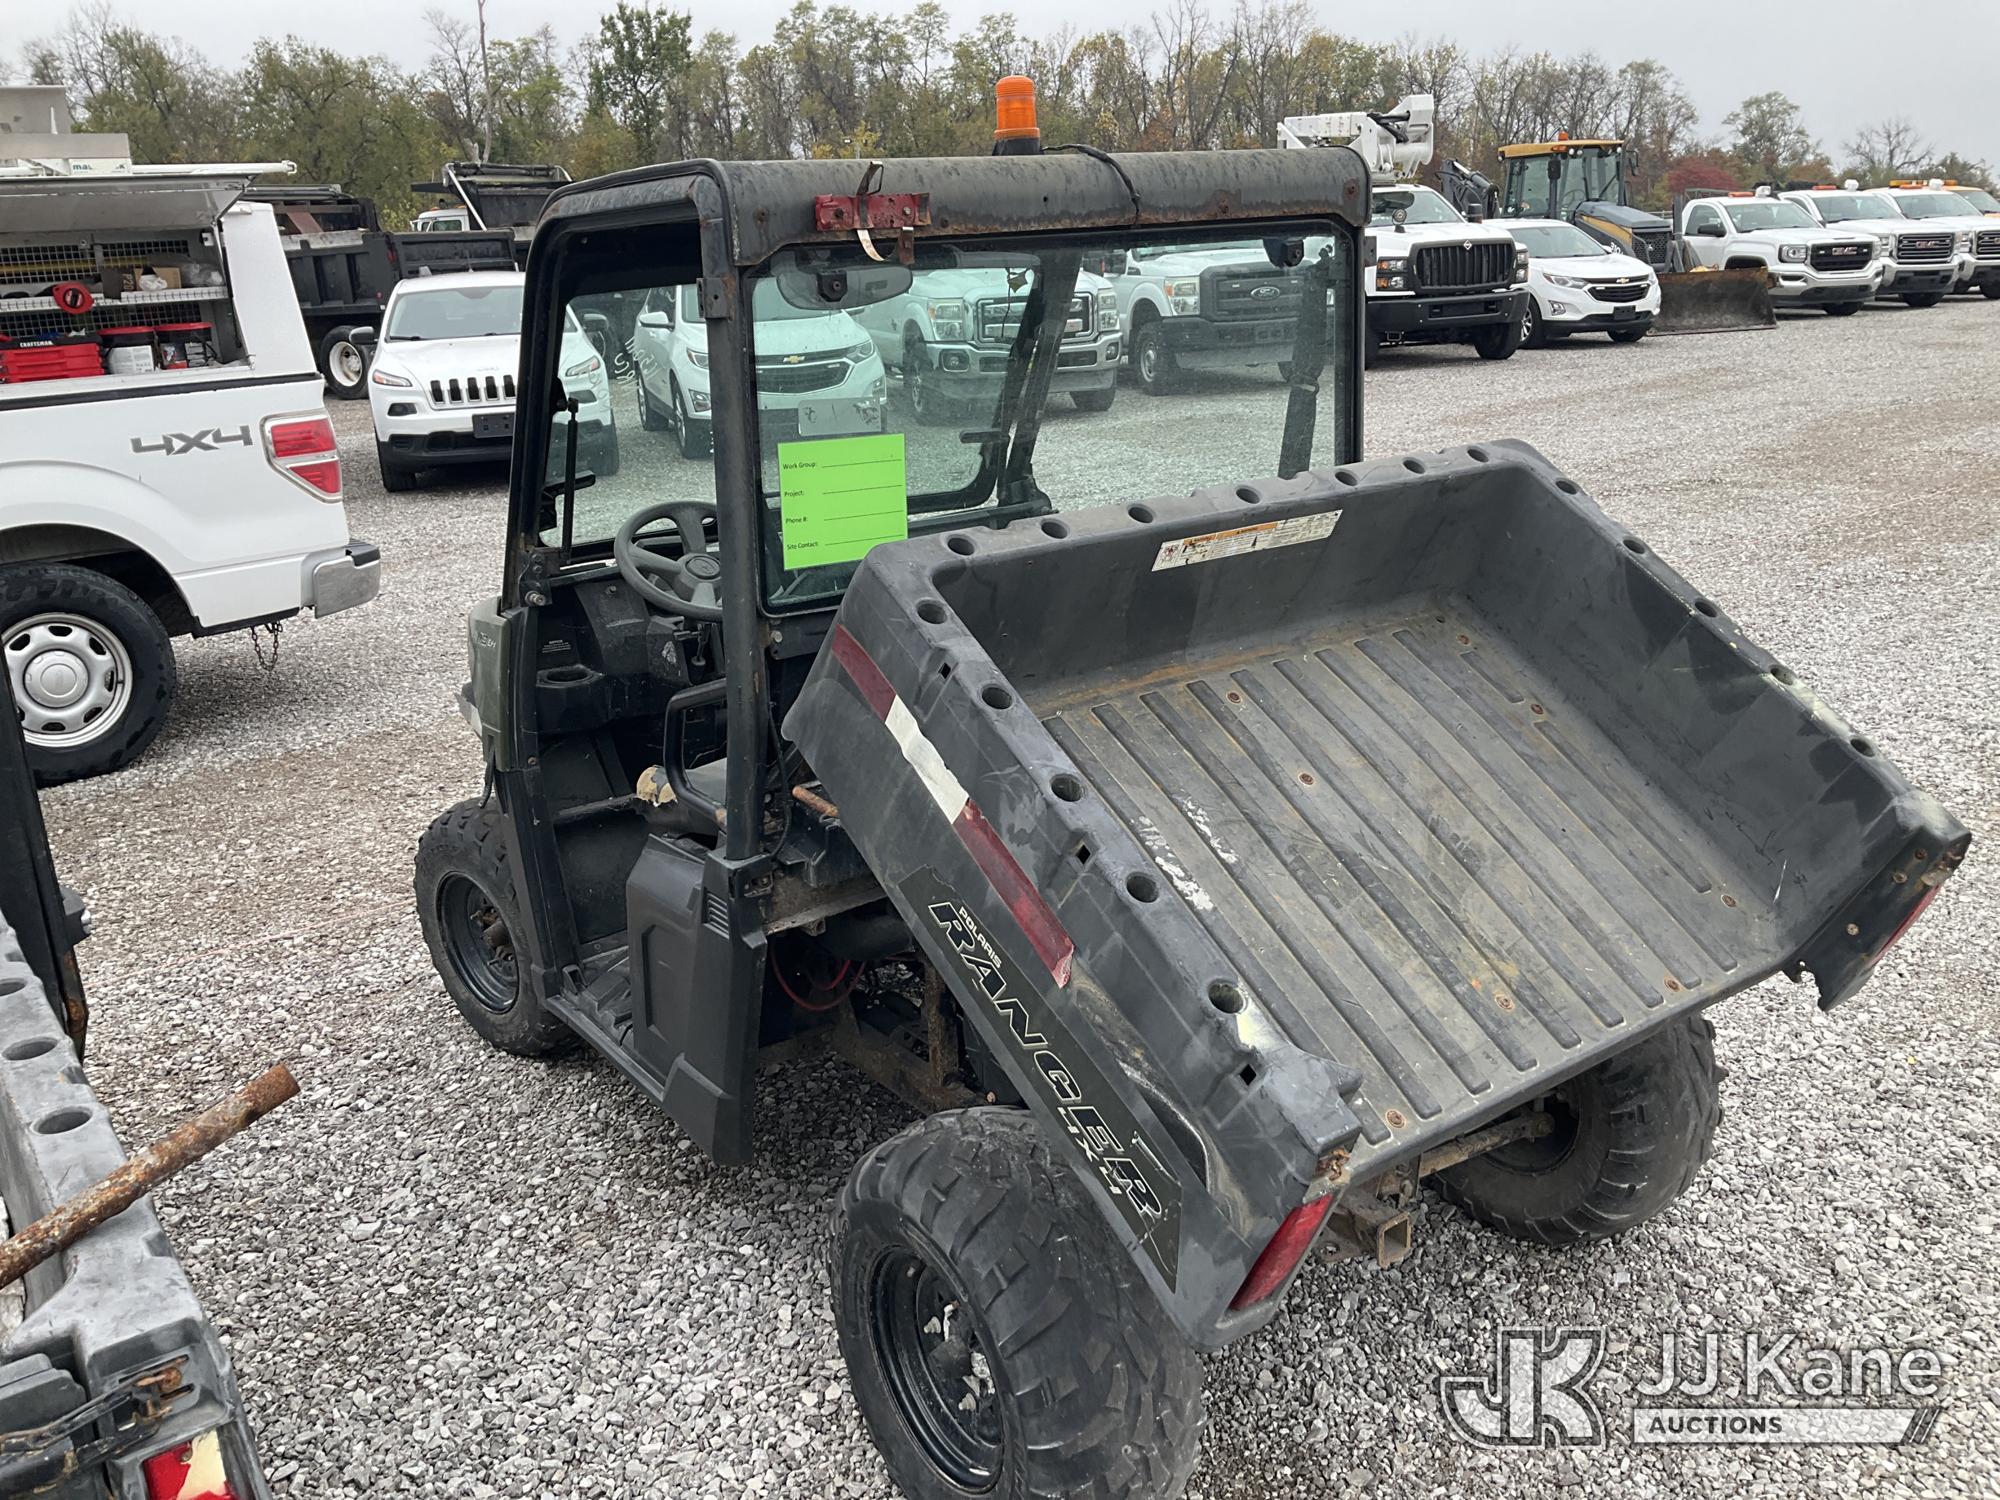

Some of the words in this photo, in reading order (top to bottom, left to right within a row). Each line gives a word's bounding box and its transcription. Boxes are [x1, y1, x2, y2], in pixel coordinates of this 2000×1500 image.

[1831, 247, 1858, 255] GMC
[958, 906, 1002, 968] POLARIS
[928, 902, 1162, 1216] RANGER
